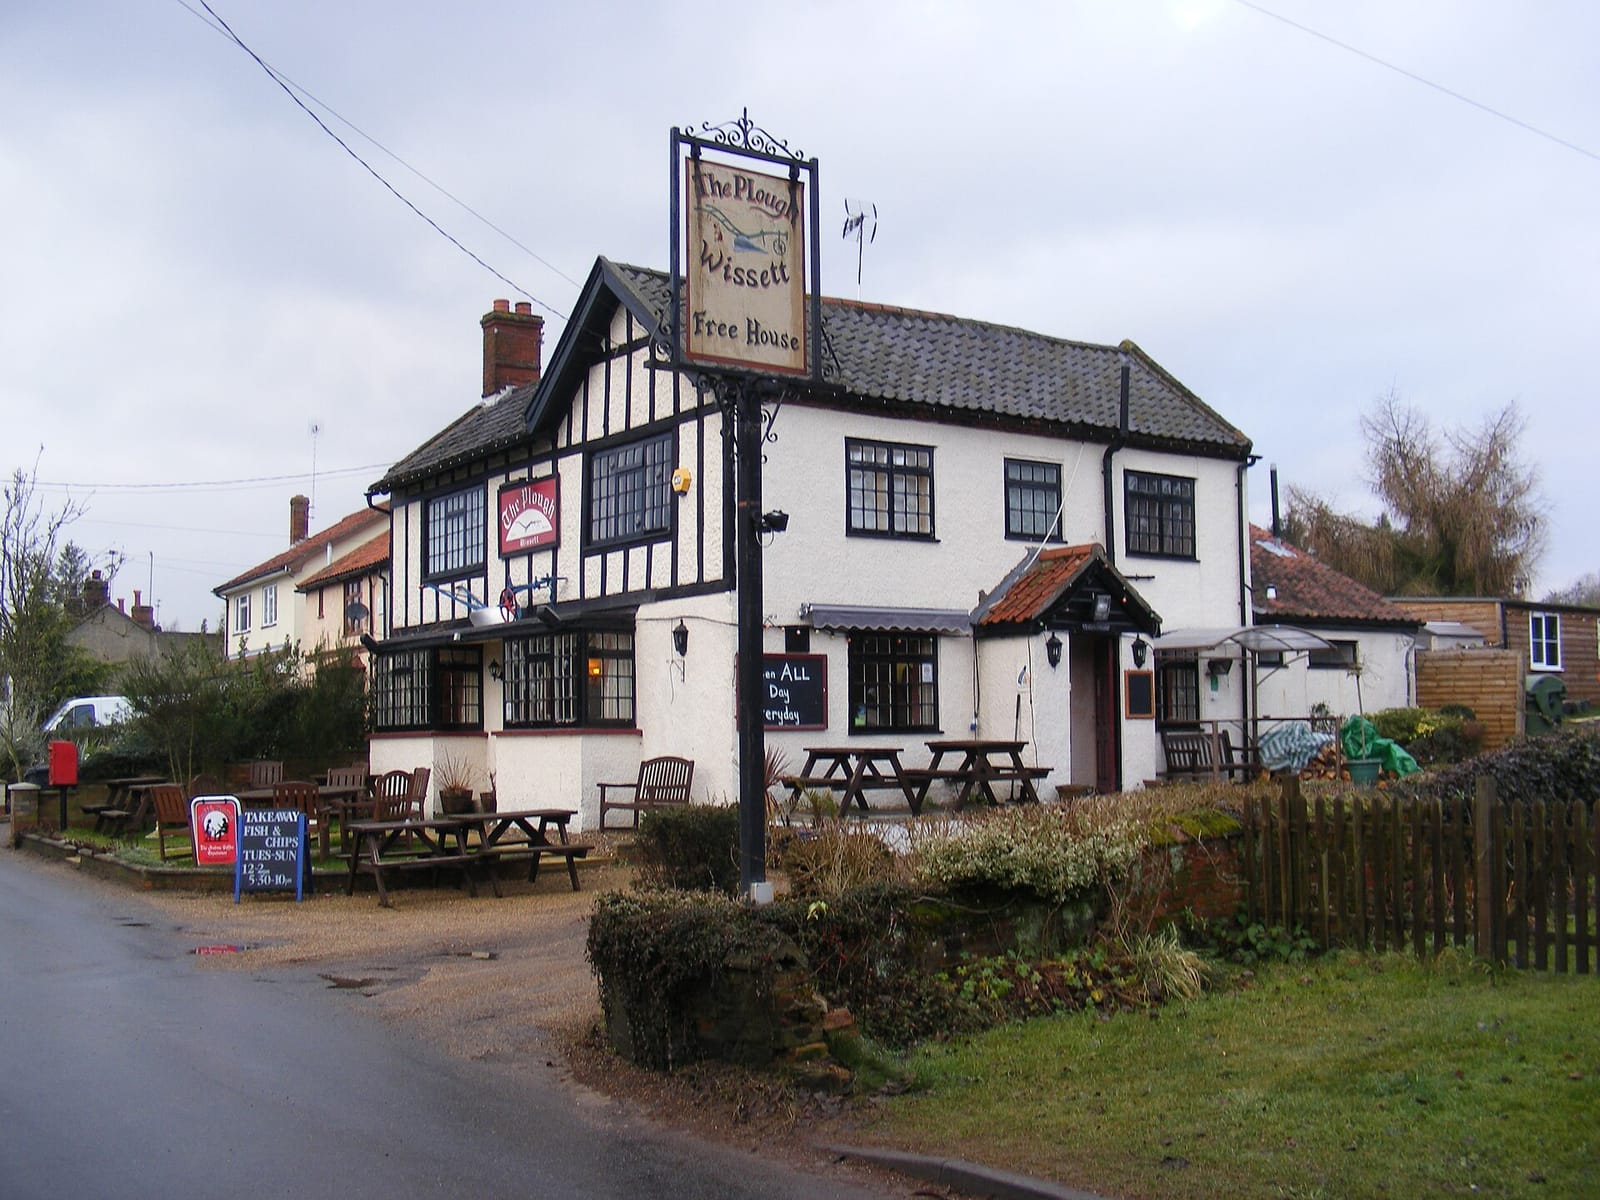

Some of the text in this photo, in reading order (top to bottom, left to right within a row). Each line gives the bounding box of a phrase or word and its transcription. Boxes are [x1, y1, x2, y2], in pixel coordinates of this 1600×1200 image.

[700, 239, 790, 288] Wissett
[693, 311, 800, 351] Free House
[522, 487, 555, 520] Plough
[780, 661, 810, 682] ALL
[769, 683, 790, 705] Day
[762, 705, 800, 726] eryday
[244, 811, 300, 823] TAKEAWAY
[243, 825, 281, 837] FISH &
[265, 836, 299, 848] CHIPS
[242, 849, 297, 861] TUES-SUN
